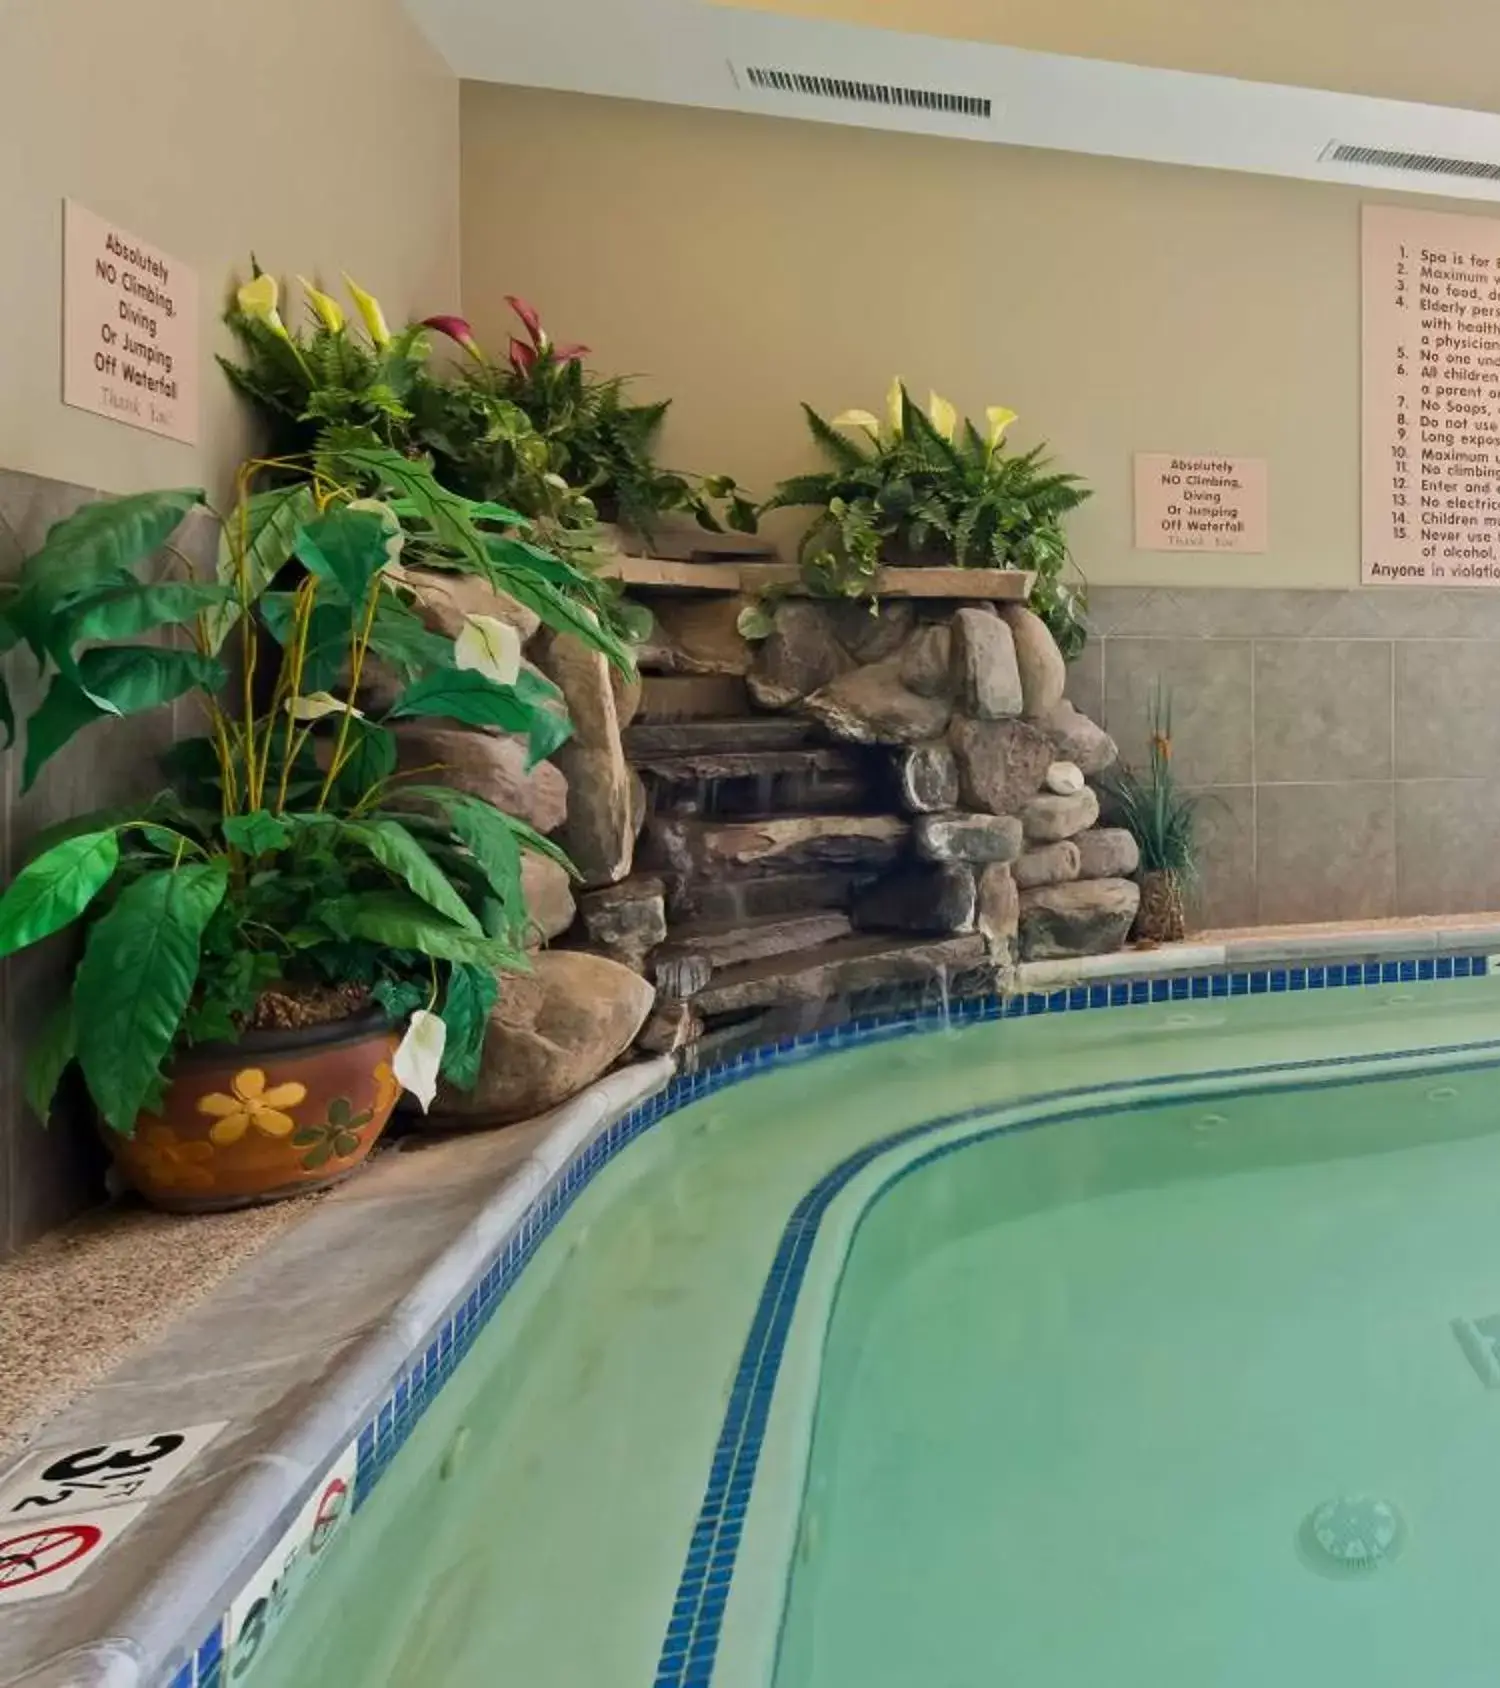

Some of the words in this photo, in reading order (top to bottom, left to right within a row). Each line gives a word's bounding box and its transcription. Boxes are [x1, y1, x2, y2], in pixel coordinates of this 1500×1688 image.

[106, 233, 168, 285] Absolutely
[1420, 250, 1446, 265] Spa
[1453, 253, 1463, 265] is
[1469, 255, 1490, 267] for
[96, 258, 117, 285] NO
[1420, 267, 1487, 284] Maximum
[1419, 283, 1439, 296] No
[1419, 300, 1465, 318] Elderly
[119, 300, 157, 338] Diving
[1421, 318, 1451, 330] with
[1457, 320, 1500, 334] health
[101, 323, 117, 344] Or
[123, 333, 172, 373] Jumping
[1421, 337, 1429, 345] a
[1435, 335, 1499, 350] physician
[1420, 350, 1438, 362] No
[1445, 355, 1470, 364] one
[94, 351, 117, 376] Off
[122, 361, 177, 399] Waterfall
[1444, 369, 1498, 382] children
[1421, 386, 1429, 394] a
[1436, 387, 1481, 398] parent
[1488, 391, 1500, 399] or
[1421, 399, 1440, 411] No
[1420, 416, 1438, 427] Do
[1445, 420, 1467, 429] not
[1474, 422, 1497, 430] use
[1421, 431, 1454, 446] Long
[1422, 448, 1488, 462] Maximum
[1171, 459, 1232, 474] Absolutely
[1421, 464, 1440, 474] No
[1161, 474, 1181, 485] NO
[1421, 480, 1457, 492] Enter
[1465, 482, 1489, 493] and
[1184, 490, 1221, 504] Diving
[1421, 496, 1439, 507] No
[1167, 505, 1181, 515] Or
[1188, 506, 1237, 519] Jumping
[1421, 513, 1477, 525] Children
[1161, 519, 1181, 531] Off
[1188, 520, 1243, 532] Waterfall
[1421, 529, 1459, 541] Never
[1467, 534, 1490, 542] use
[1421, 546, 1436, 556] of
[1371, 563, 1424, 579] Anyone
[1431, 565, 1444, 577] in
